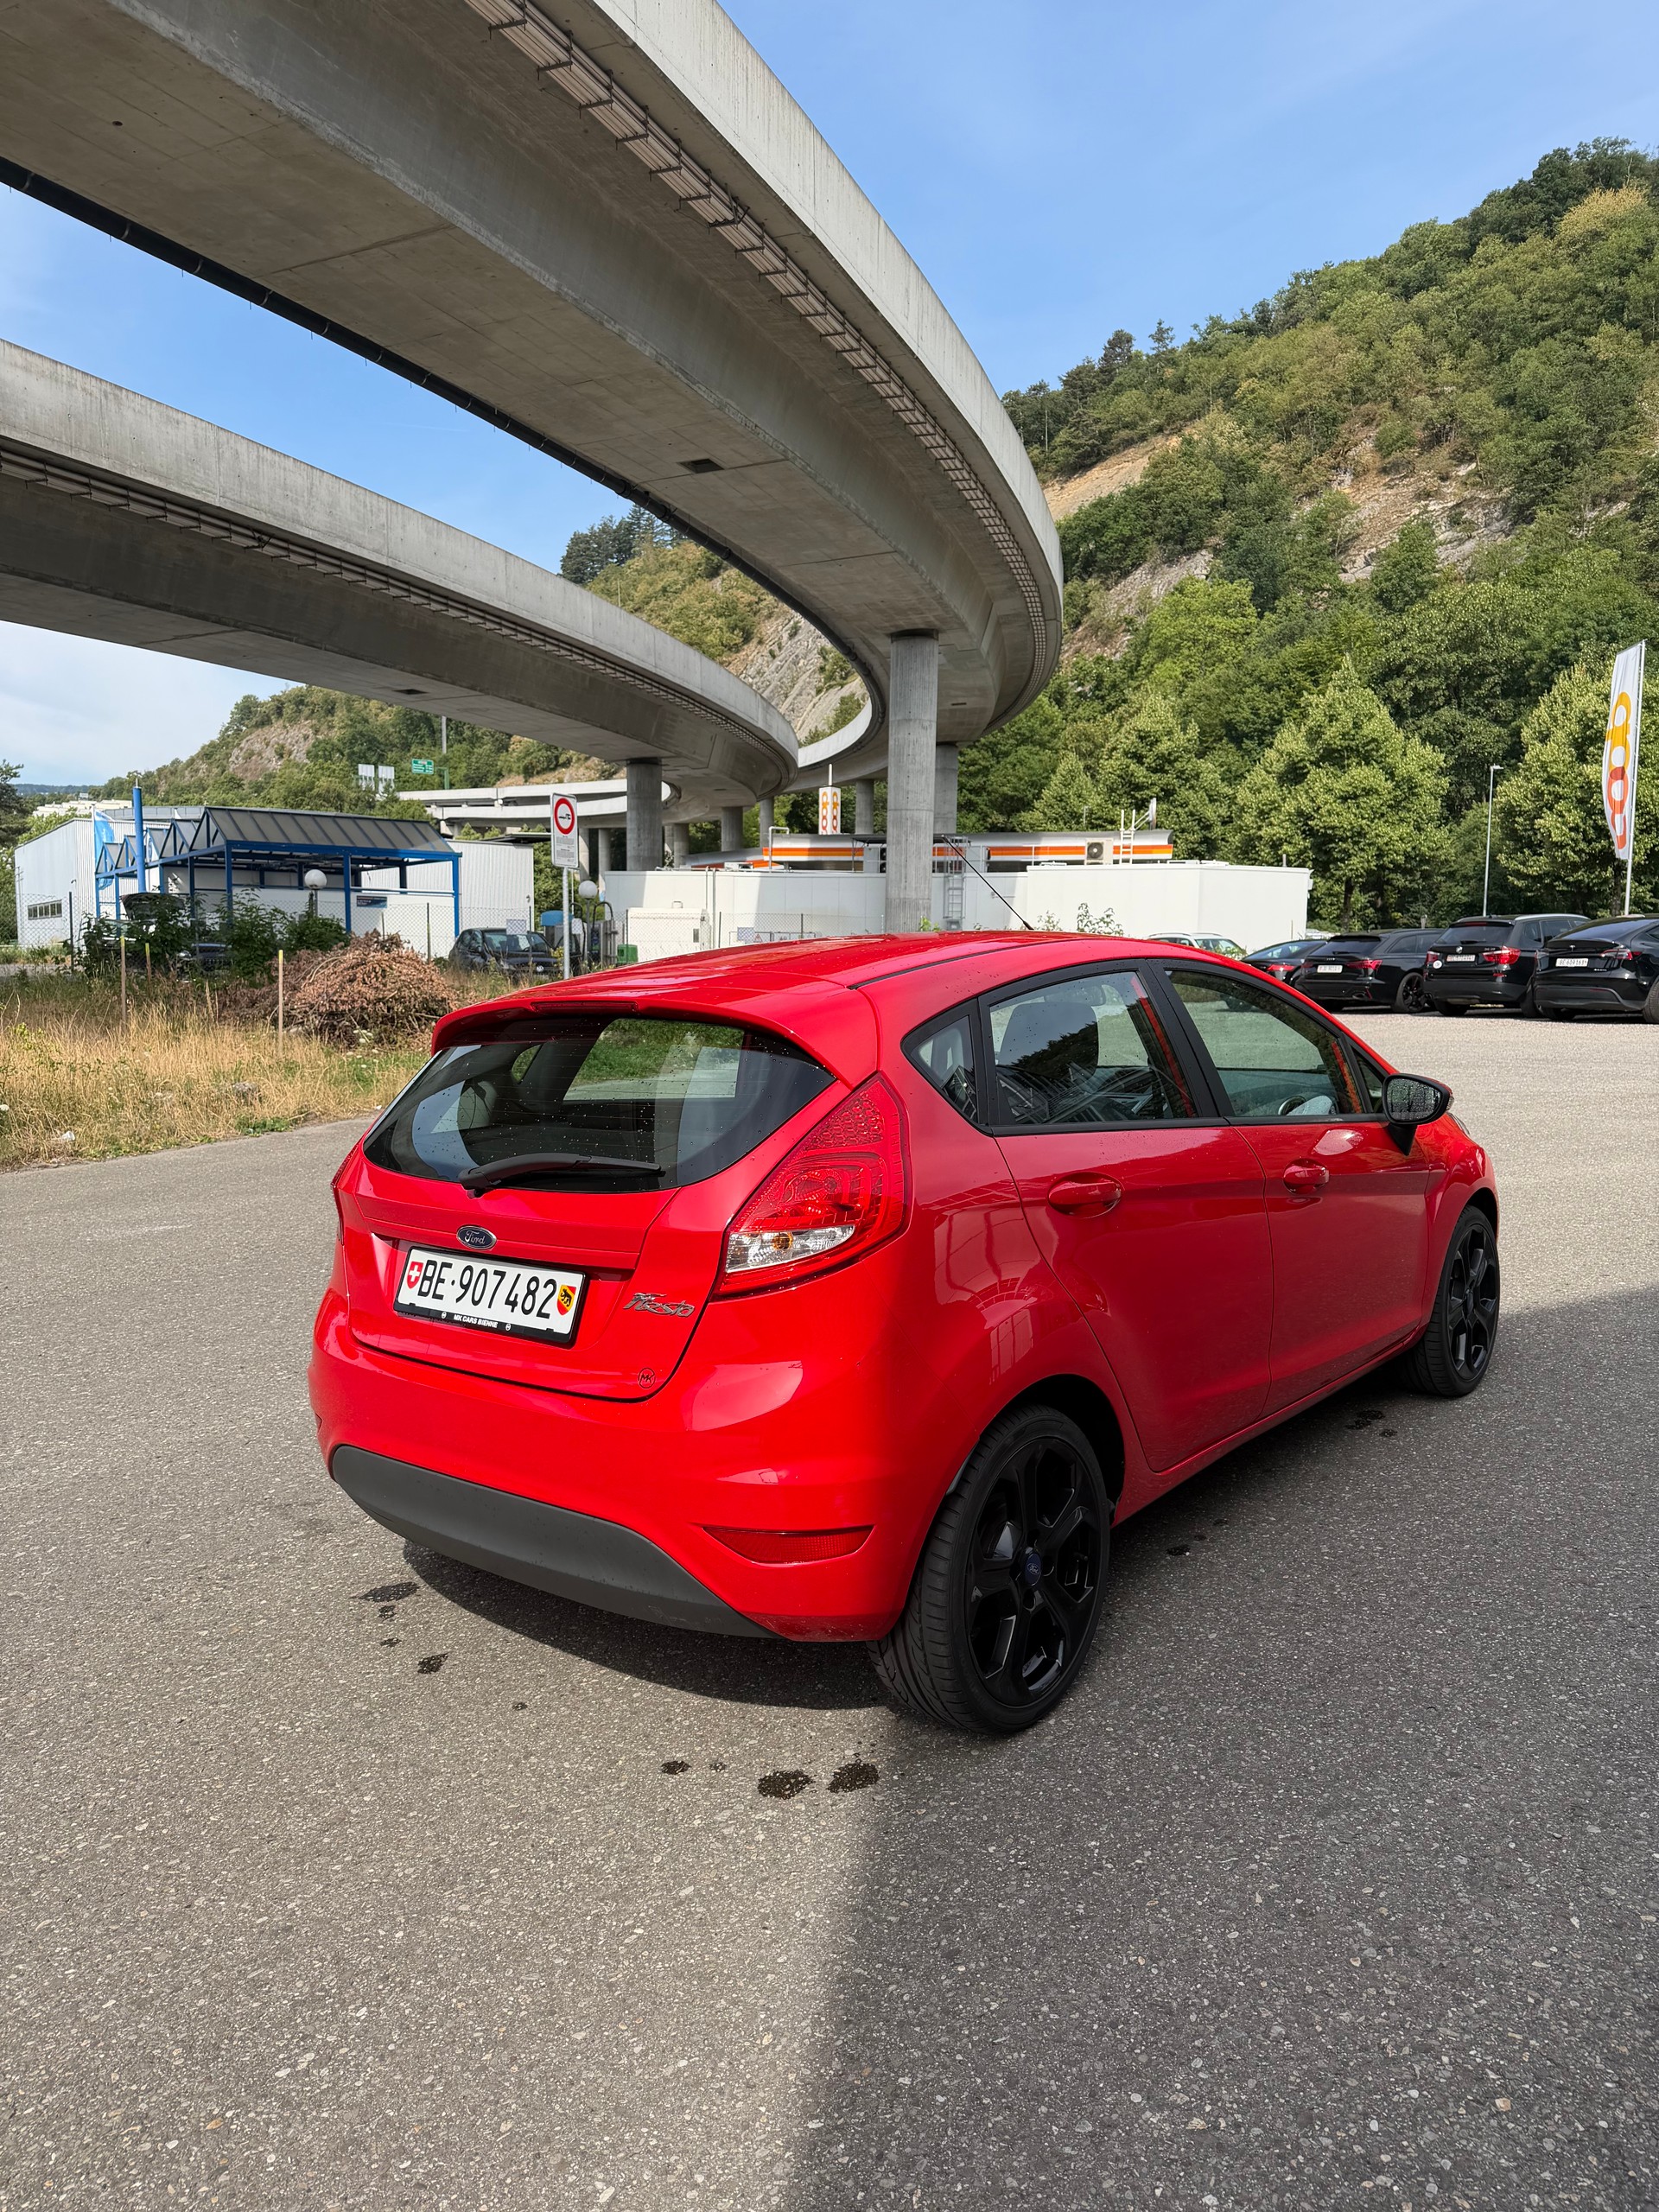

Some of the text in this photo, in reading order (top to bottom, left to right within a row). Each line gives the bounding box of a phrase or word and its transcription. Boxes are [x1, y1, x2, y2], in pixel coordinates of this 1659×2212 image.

[464, 1230, 486, 1245] Ford
[623, 1293, 695, 1318] Fiesta
[461, 1315, 478, 1325] CARS
[477, 1318, 498, 1328] BIENNE
